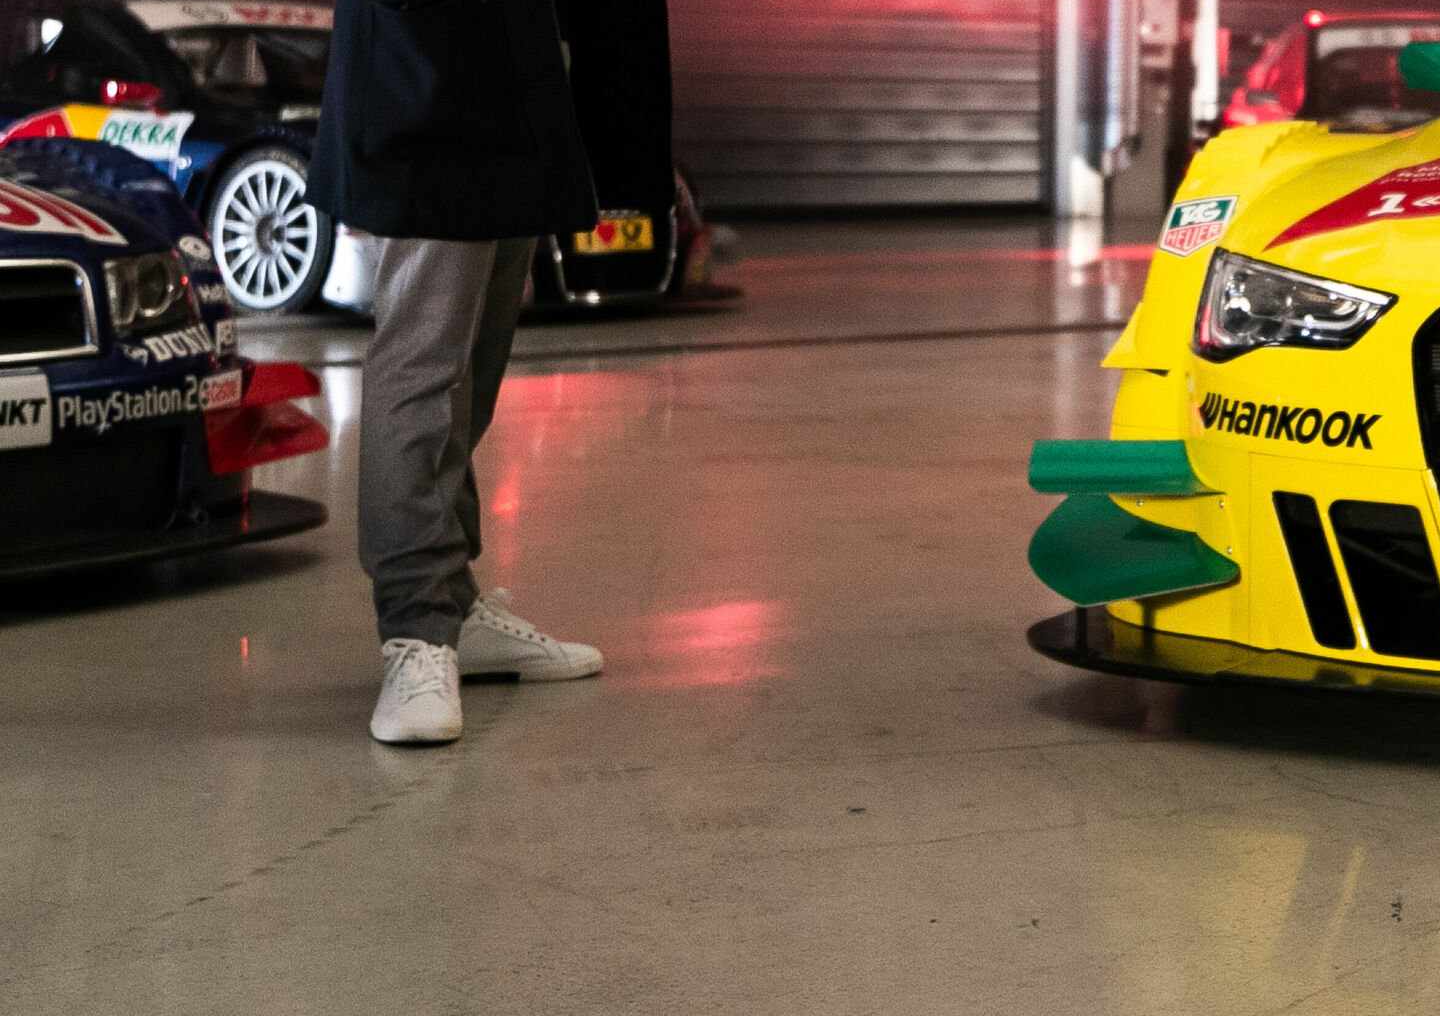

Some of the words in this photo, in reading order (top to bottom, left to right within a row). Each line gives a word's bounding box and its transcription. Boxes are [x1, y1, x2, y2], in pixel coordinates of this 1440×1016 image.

[102, 120, 178, 146] DEKRA
[1180, 201, 1222, 226] TAG
[1367, 193, 1407, 217] 1
[1166, 224, 1221, 250] HEUER
[58, 386, 182, 435] PlayStation
[185, 375, 199, 412] 2
